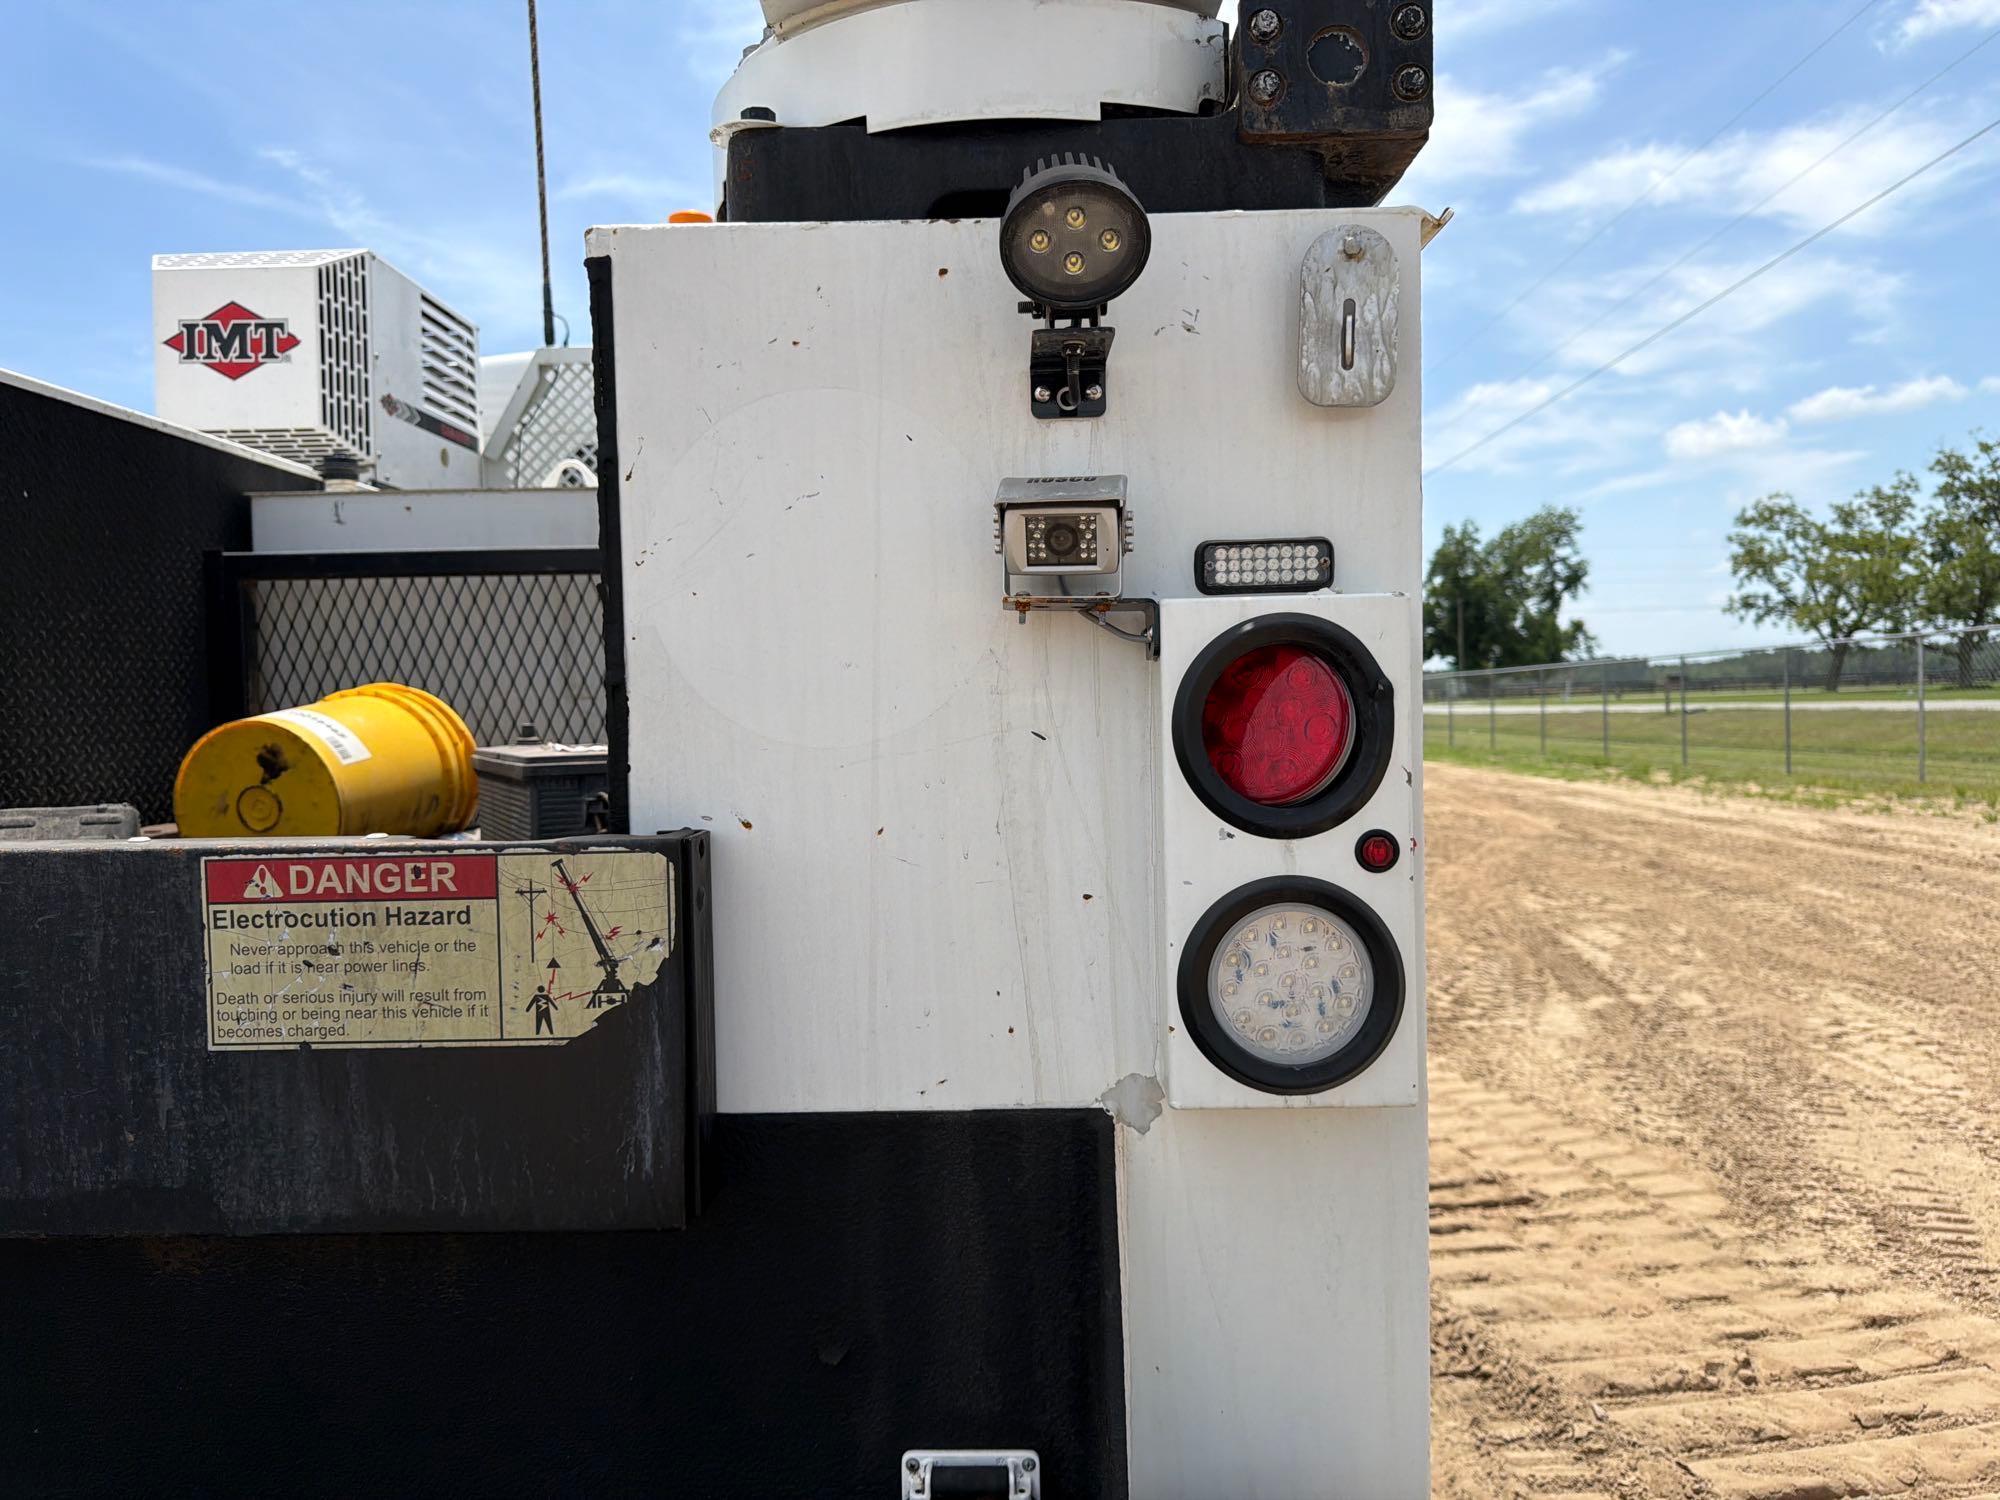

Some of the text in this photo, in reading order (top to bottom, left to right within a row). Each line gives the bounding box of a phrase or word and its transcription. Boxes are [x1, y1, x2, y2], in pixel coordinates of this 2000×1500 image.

[182, 322, 285, 360] IMT
[289, 861, 459, 895] DANGER
[212, 904, 471, 930] Electrocution Hazard
[230, 943, 273, 956] Never
[349, 941, 375, 954] this
[379, 940, 430, 954] vehicle
[434, 941, 450, 952] or
[453, 939, 477, 952] the
[230, 961, 261, 975] load
[265, 961, 274, 974] if
[278, 961, 287, 974] it
[290, 962, 302, 973] is
[344, 961, 388, 976] power
[392, 959, 430, 973] lines.
[216, 988, 487, 1006] Death or serious injury will result from
[217, 1004, 489, 1024] touching or being near this vehicle if it
[217, 1023, 350, 1039] becomes charged.
